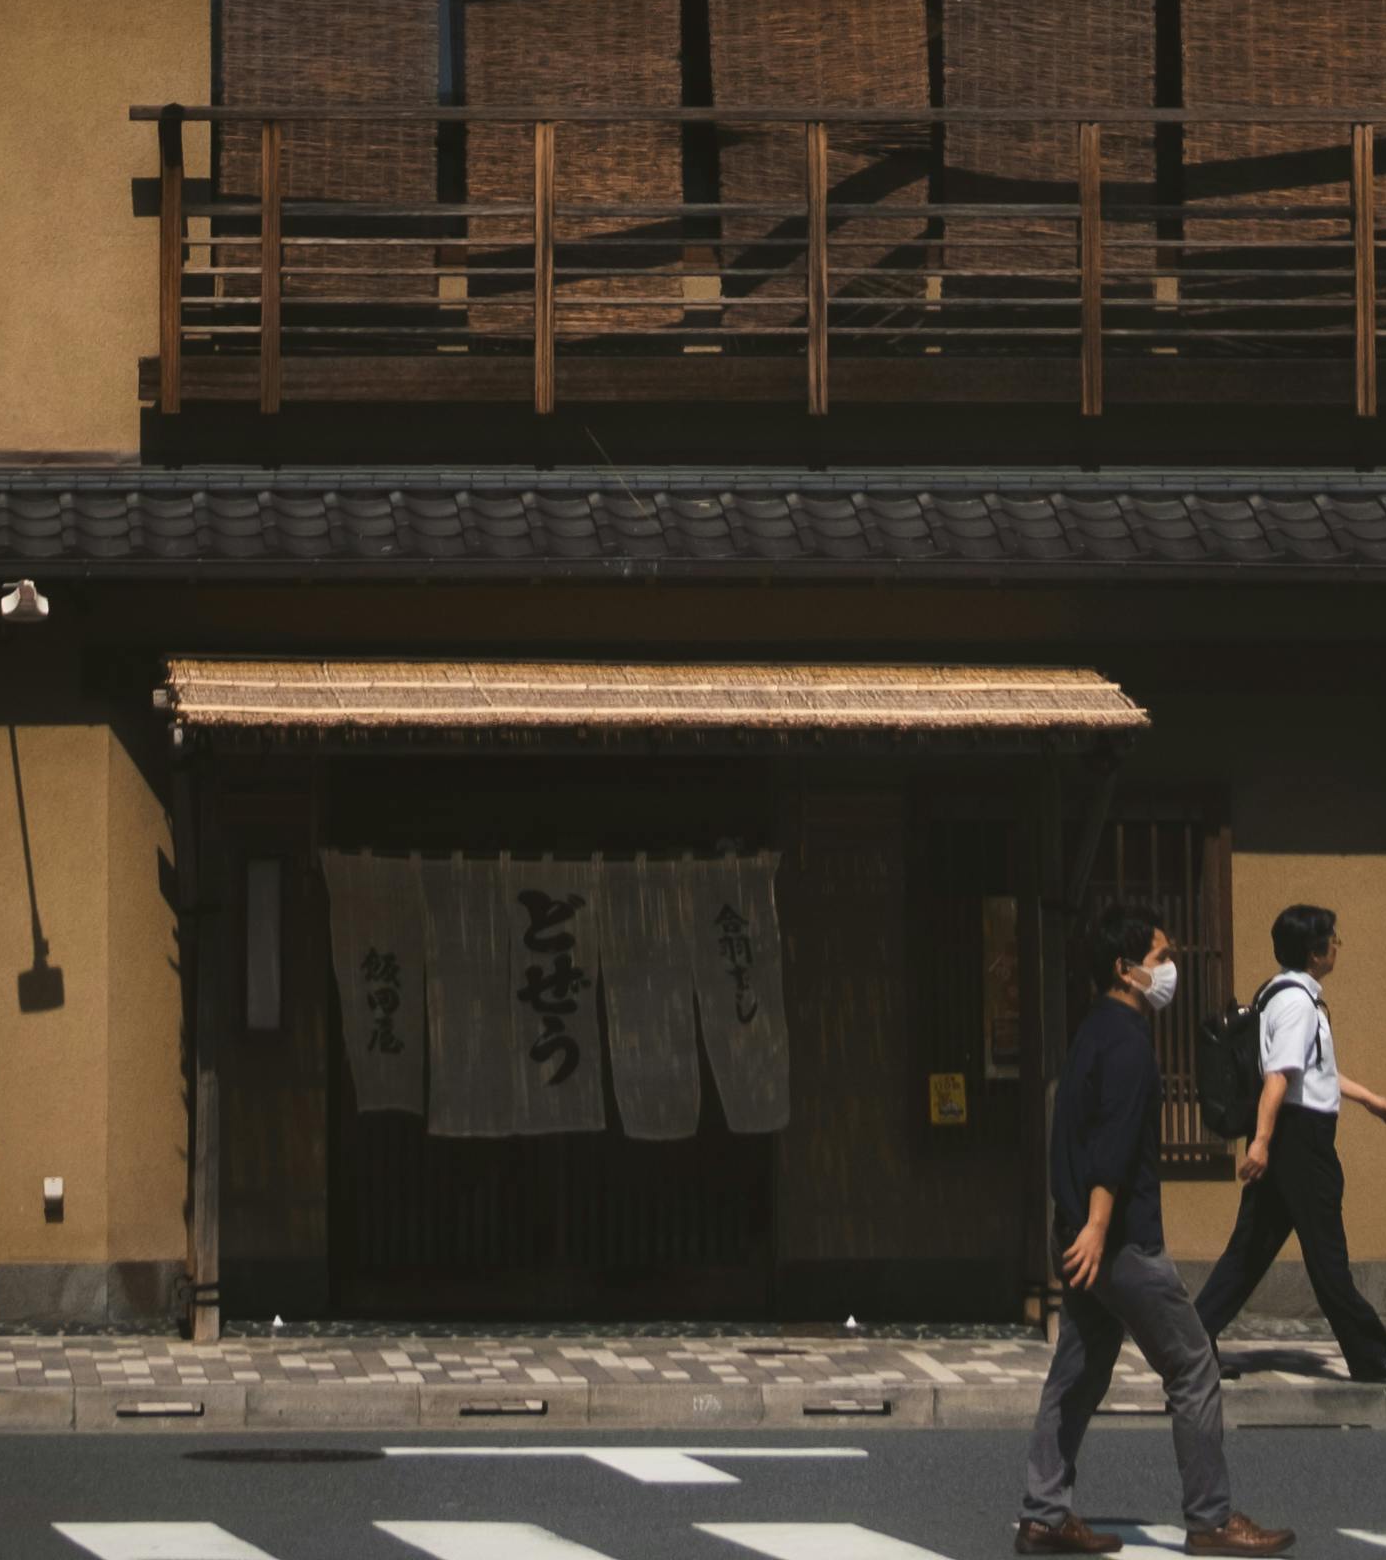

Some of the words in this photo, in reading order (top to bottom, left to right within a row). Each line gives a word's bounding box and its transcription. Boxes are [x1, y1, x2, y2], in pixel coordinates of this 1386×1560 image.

[361, 946, 406, 1054] 飯田屋
[517, 887, 591, 1087] どぜう
